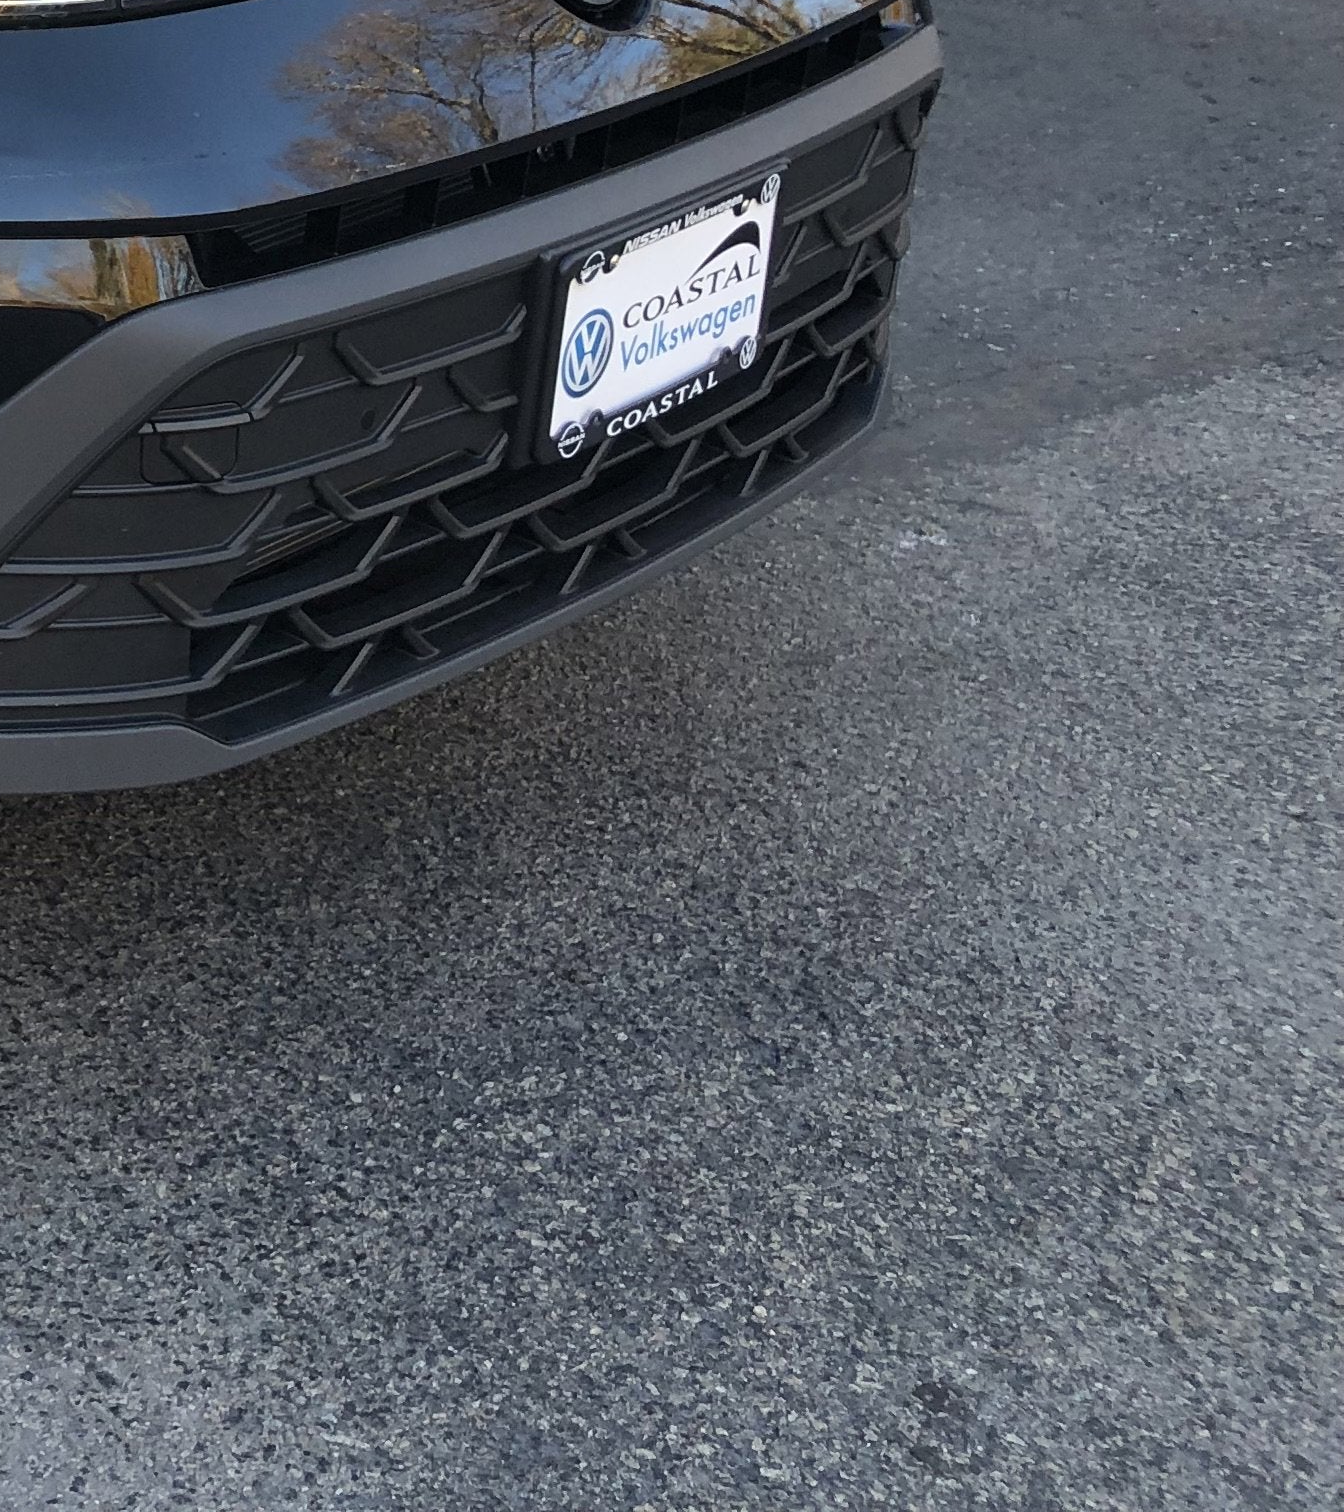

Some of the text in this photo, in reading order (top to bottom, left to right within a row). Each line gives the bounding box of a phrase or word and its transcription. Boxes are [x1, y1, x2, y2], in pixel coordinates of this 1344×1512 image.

[622, 220, 682, 255] NISSAN
[622, 253, 761, 328] COASTAL
[620, 293, 756, 373] Volkswagen
[606, 370, 718, 437] COASTAL
